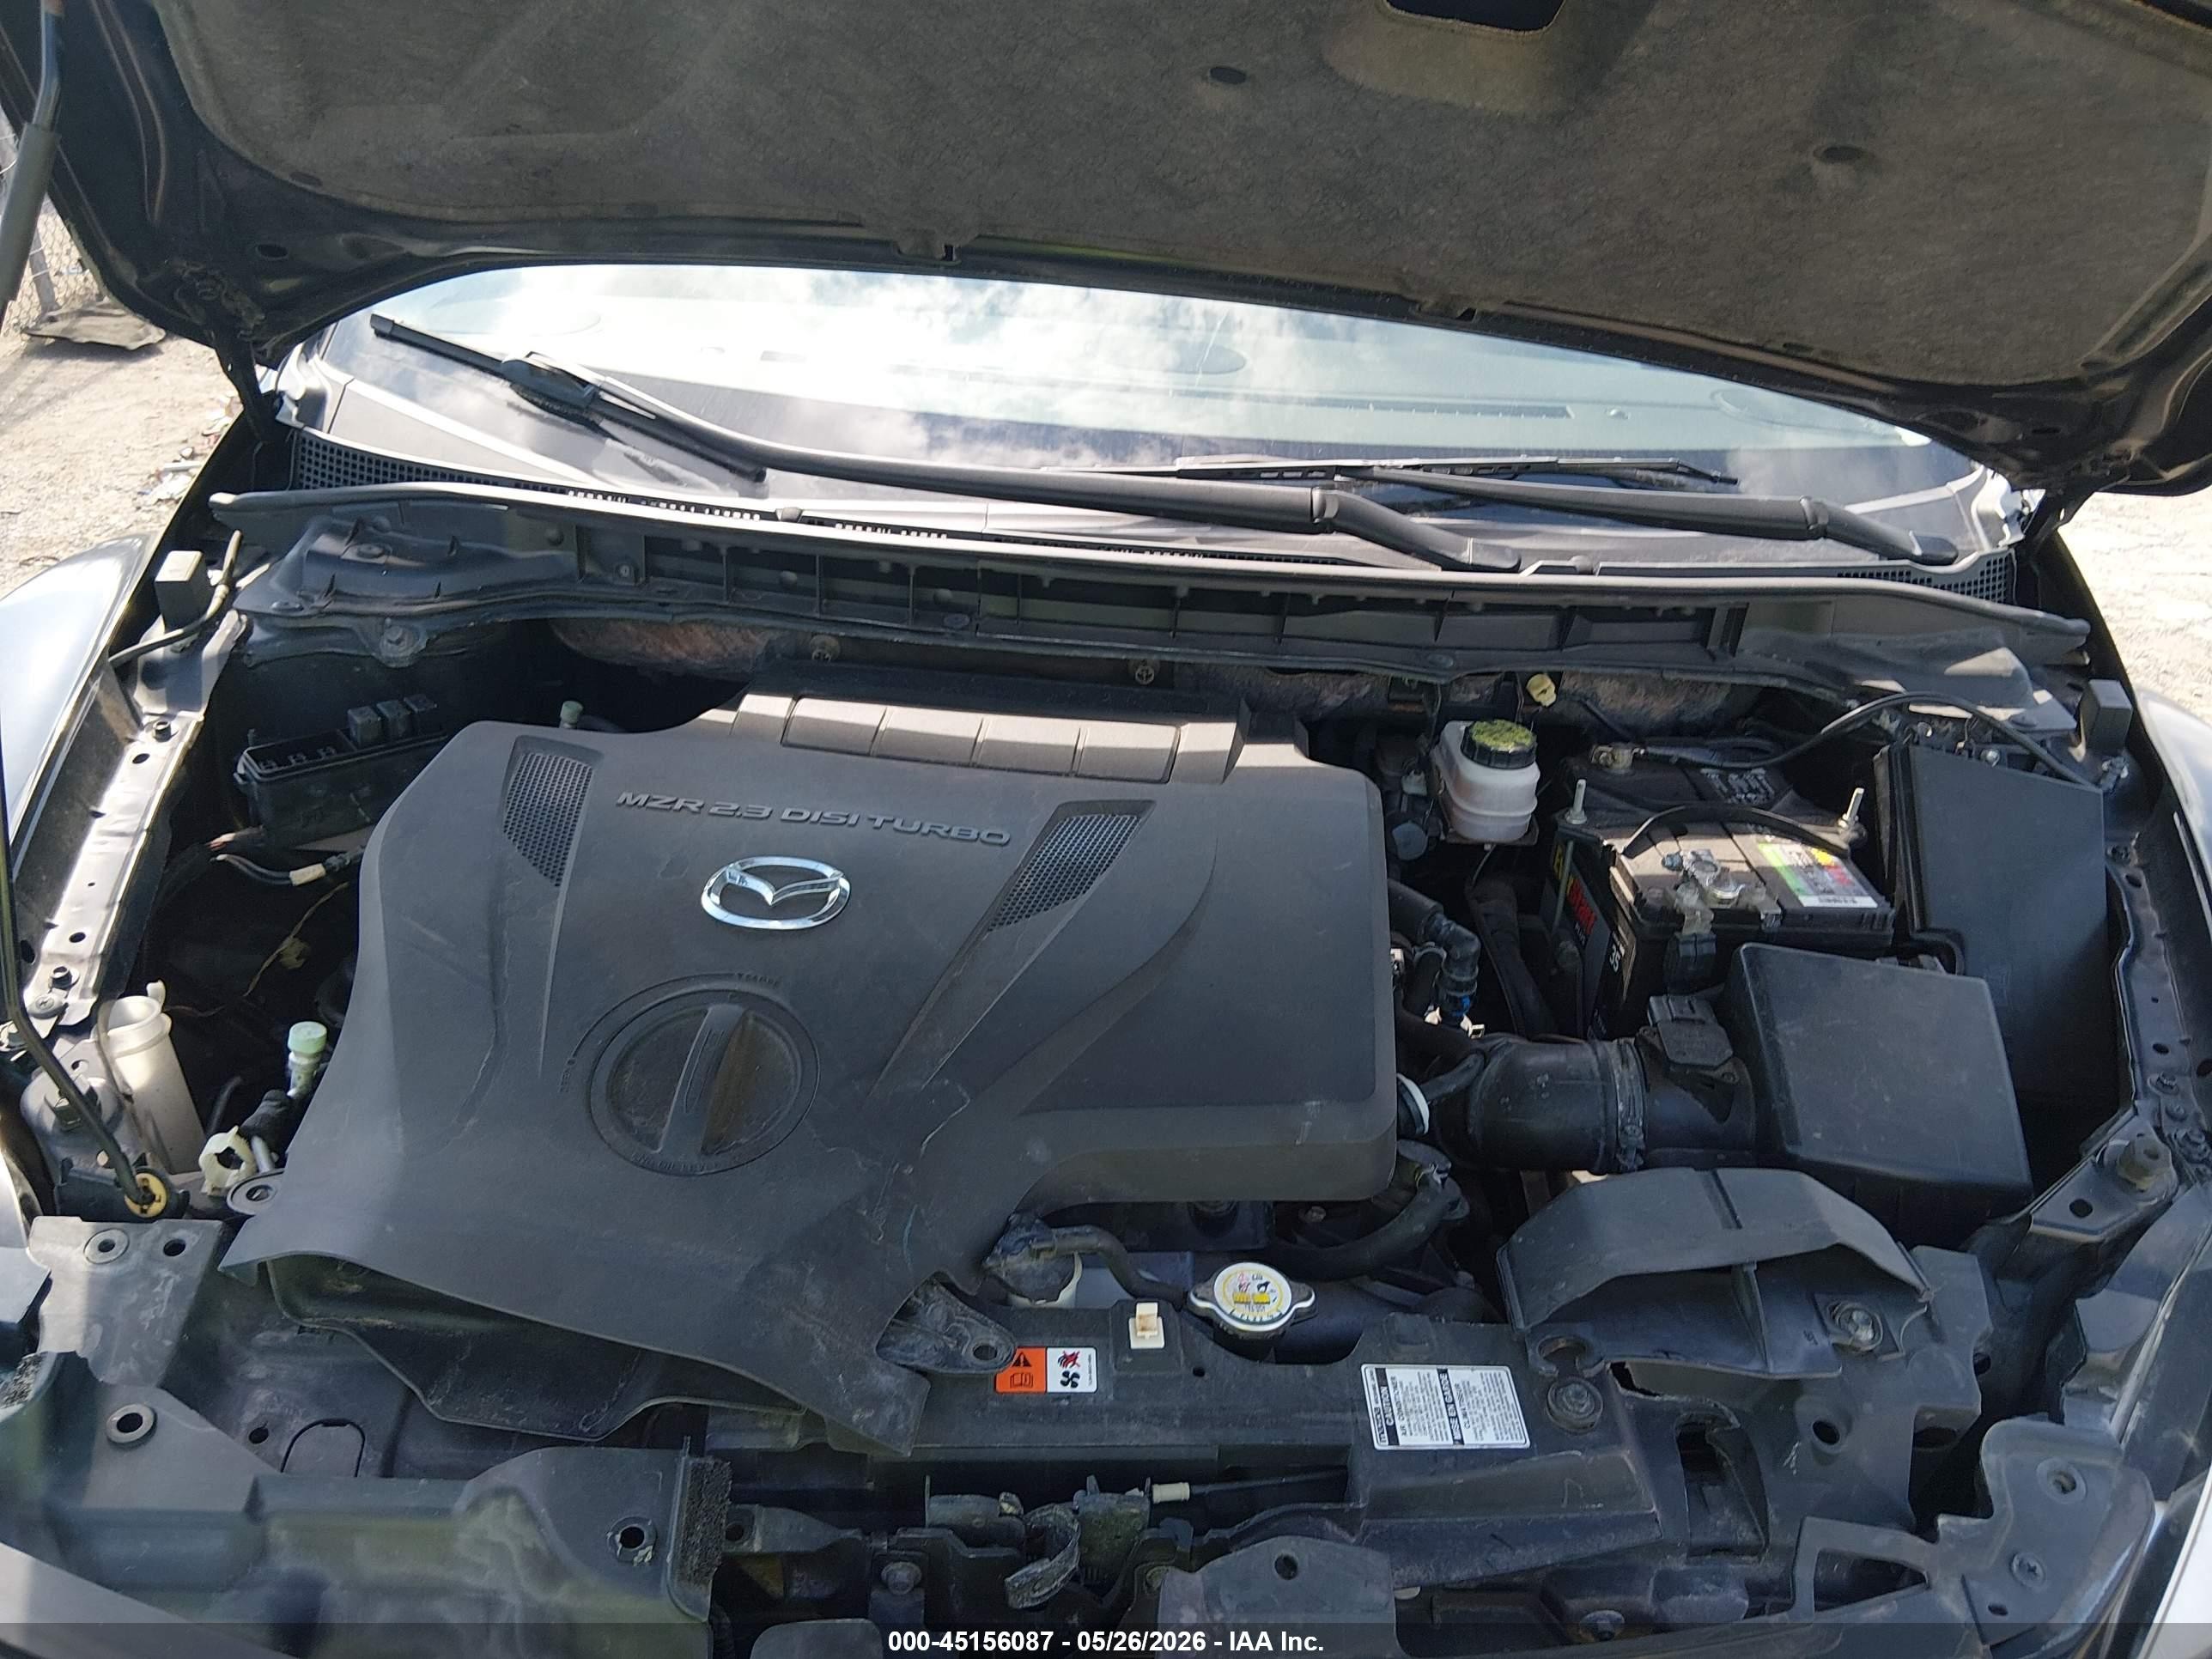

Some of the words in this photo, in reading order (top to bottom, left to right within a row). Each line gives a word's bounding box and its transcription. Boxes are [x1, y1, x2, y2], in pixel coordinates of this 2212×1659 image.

[617, 791, 703, 813] MZR
[709, 800, 772, 820] 2.3
[781, 808, 859, 827] DISI
[869, 815, 1010, 846] TURBO
[1379, 1386, 1395, 1425] CAUTION
[1438, 1373, 1453, 1402] GARDE
